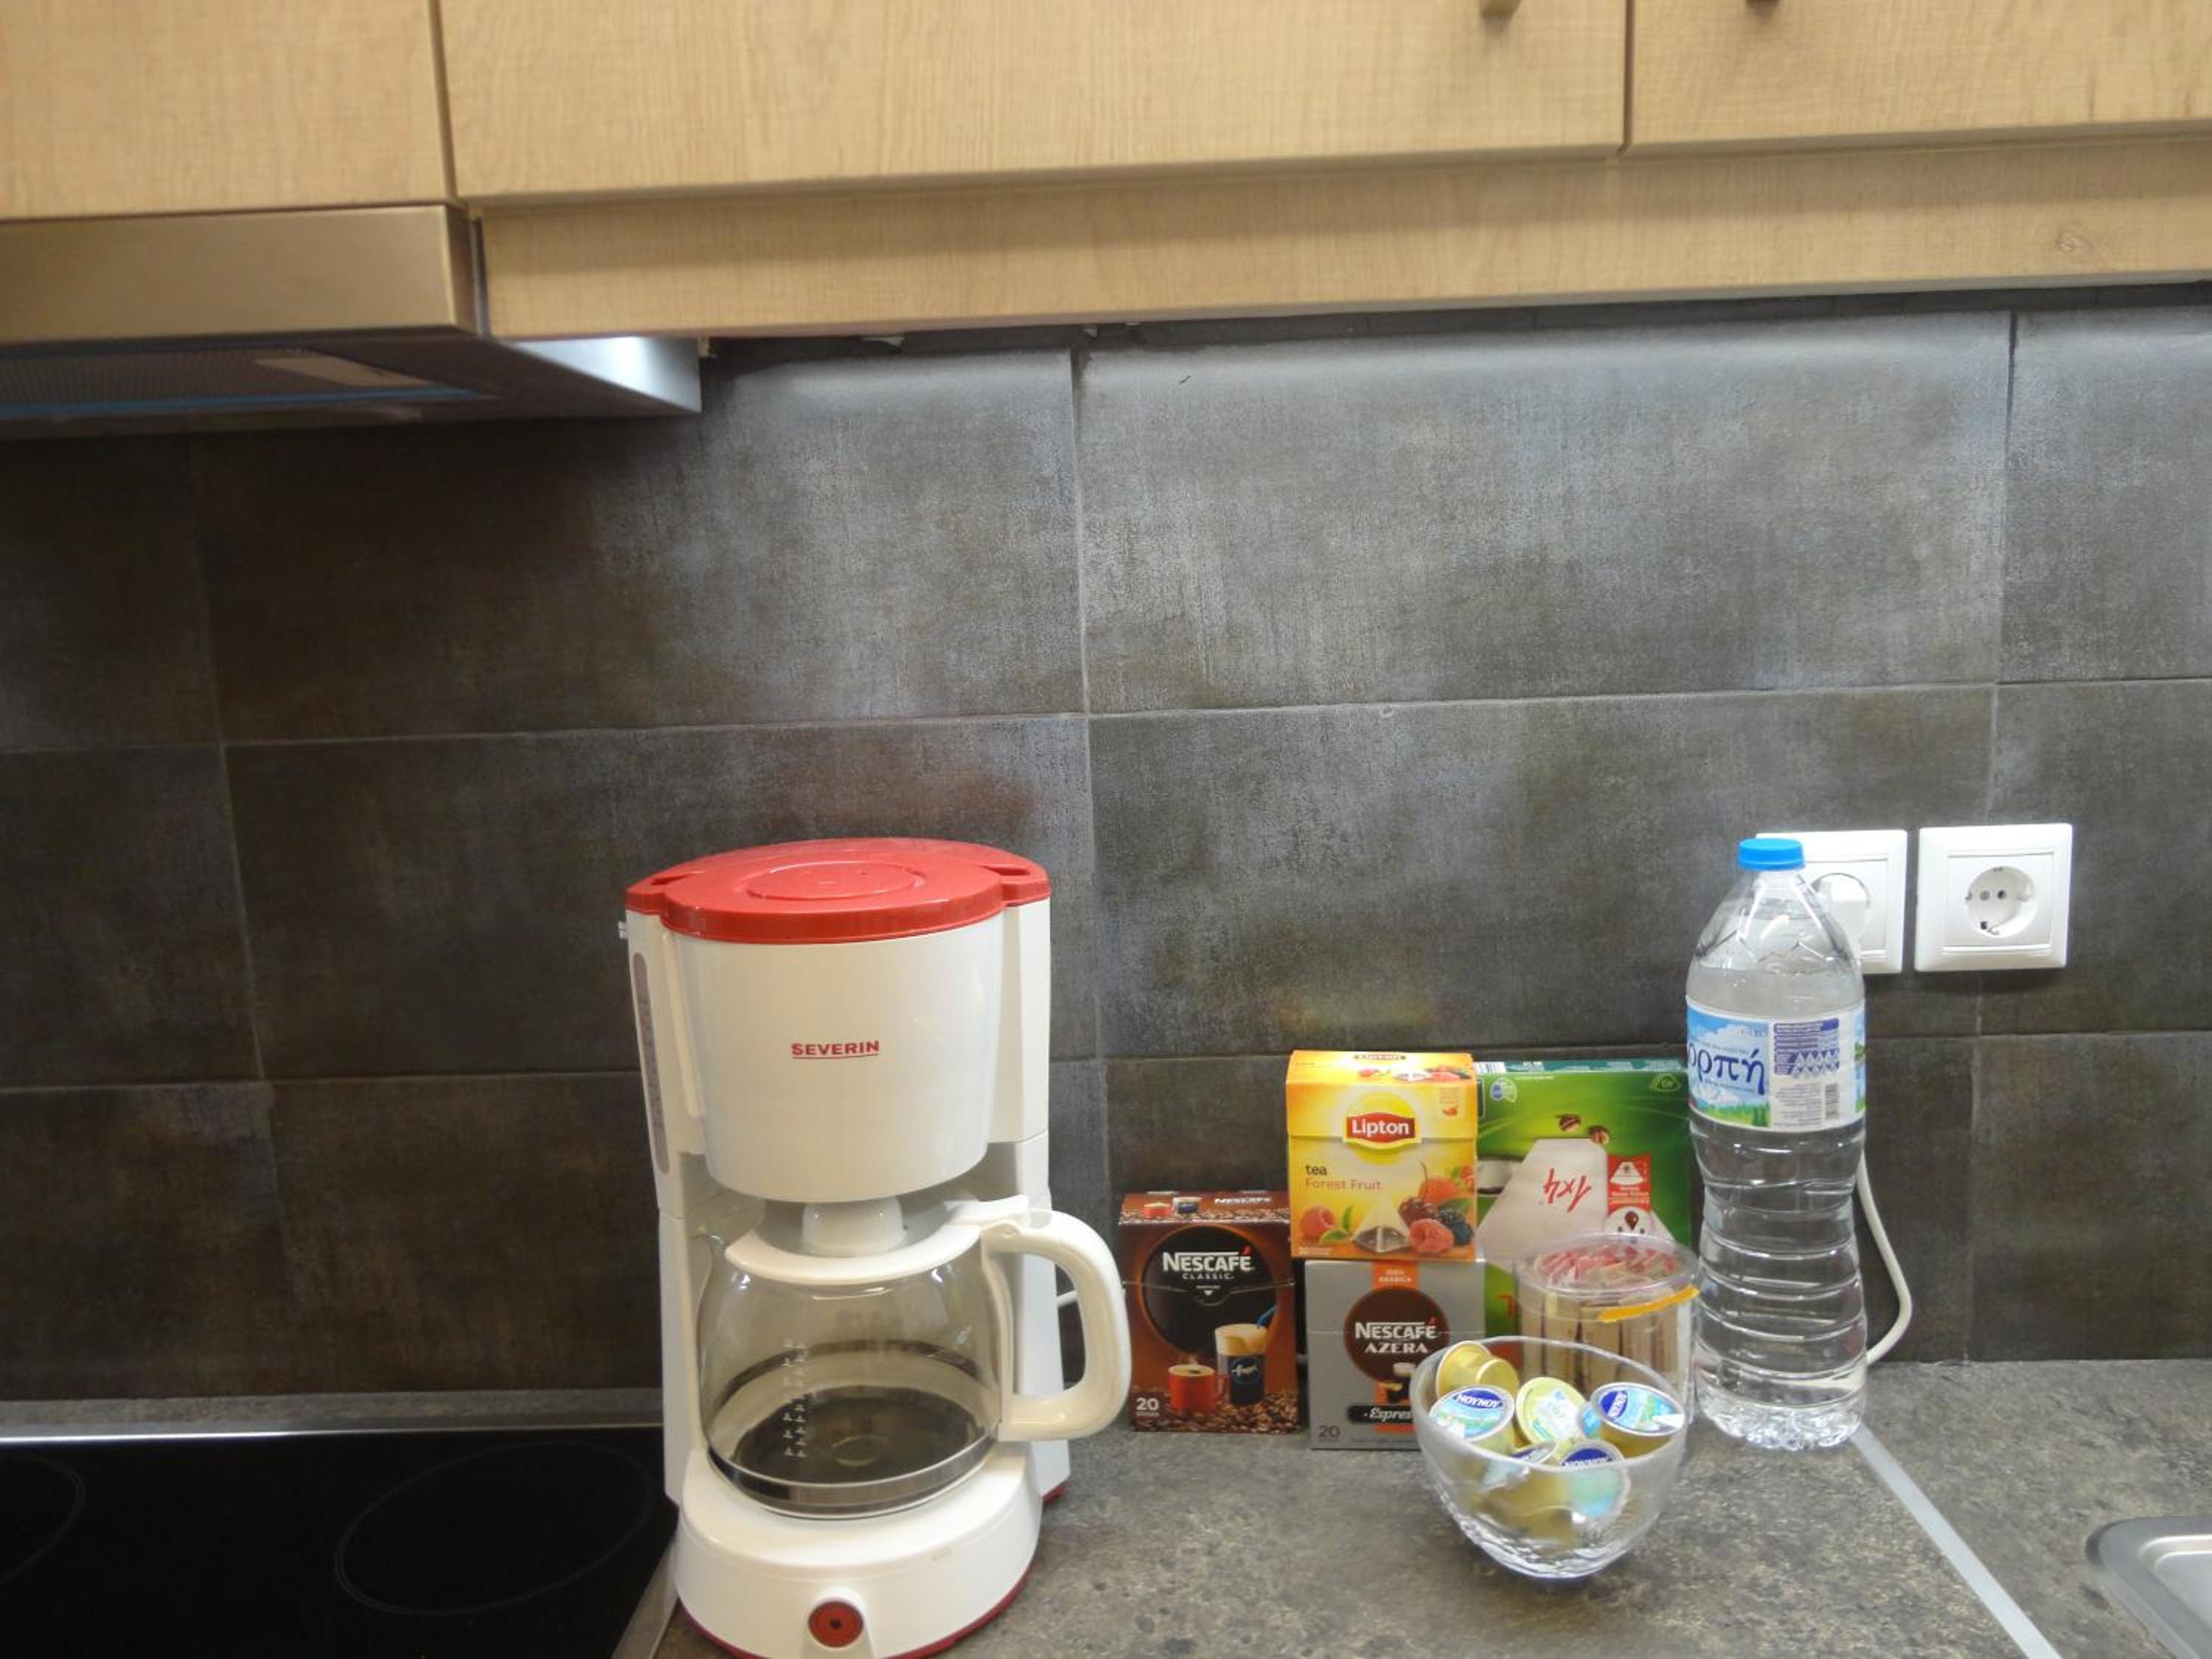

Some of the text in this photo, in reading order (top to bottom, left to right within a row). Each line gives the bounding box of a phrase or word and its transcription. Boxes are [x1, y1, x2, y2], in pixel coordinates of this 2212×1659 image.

[791, 1040, 880, 1056] SEVERIN
[1351, 1119, 1410, 1138] Lipton
[1305, 1164, 1328, 1176] tea
[1305, 1179, 1382, 1191] Forest Fruit
[1364, 1342, 1428, 1354] AZERA
[1135, 1397, 1160, 1411] 20
[1318, 1425, 1340, 1438] 20
